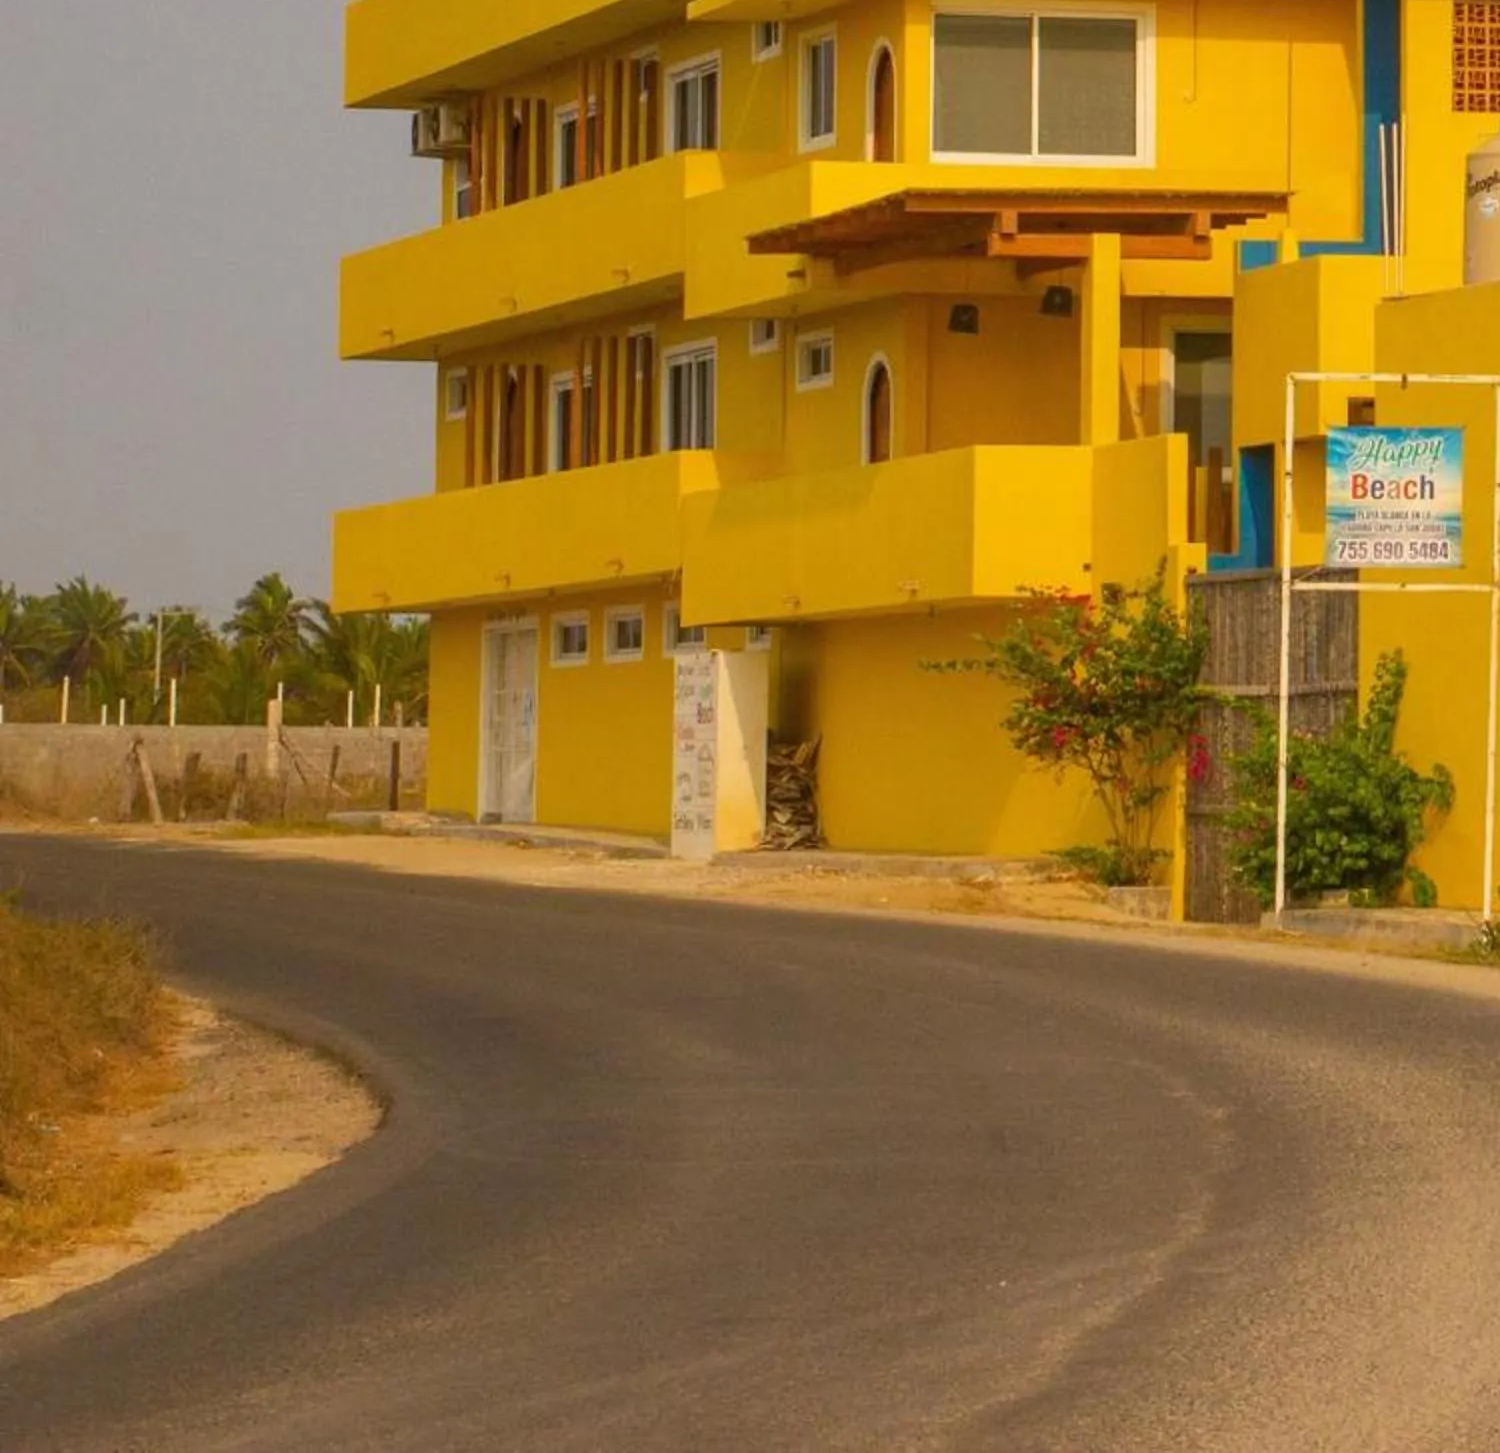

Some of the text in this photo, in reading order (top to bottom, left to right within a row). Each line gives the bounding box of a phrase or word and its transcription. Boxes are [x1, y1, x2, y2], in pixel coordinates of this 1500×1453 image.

[1350, 434, 1443, 469] Happy
[1351, 473, 1435, 500] Beach
[1338, 540, 1449, 559] 755 690 5484
